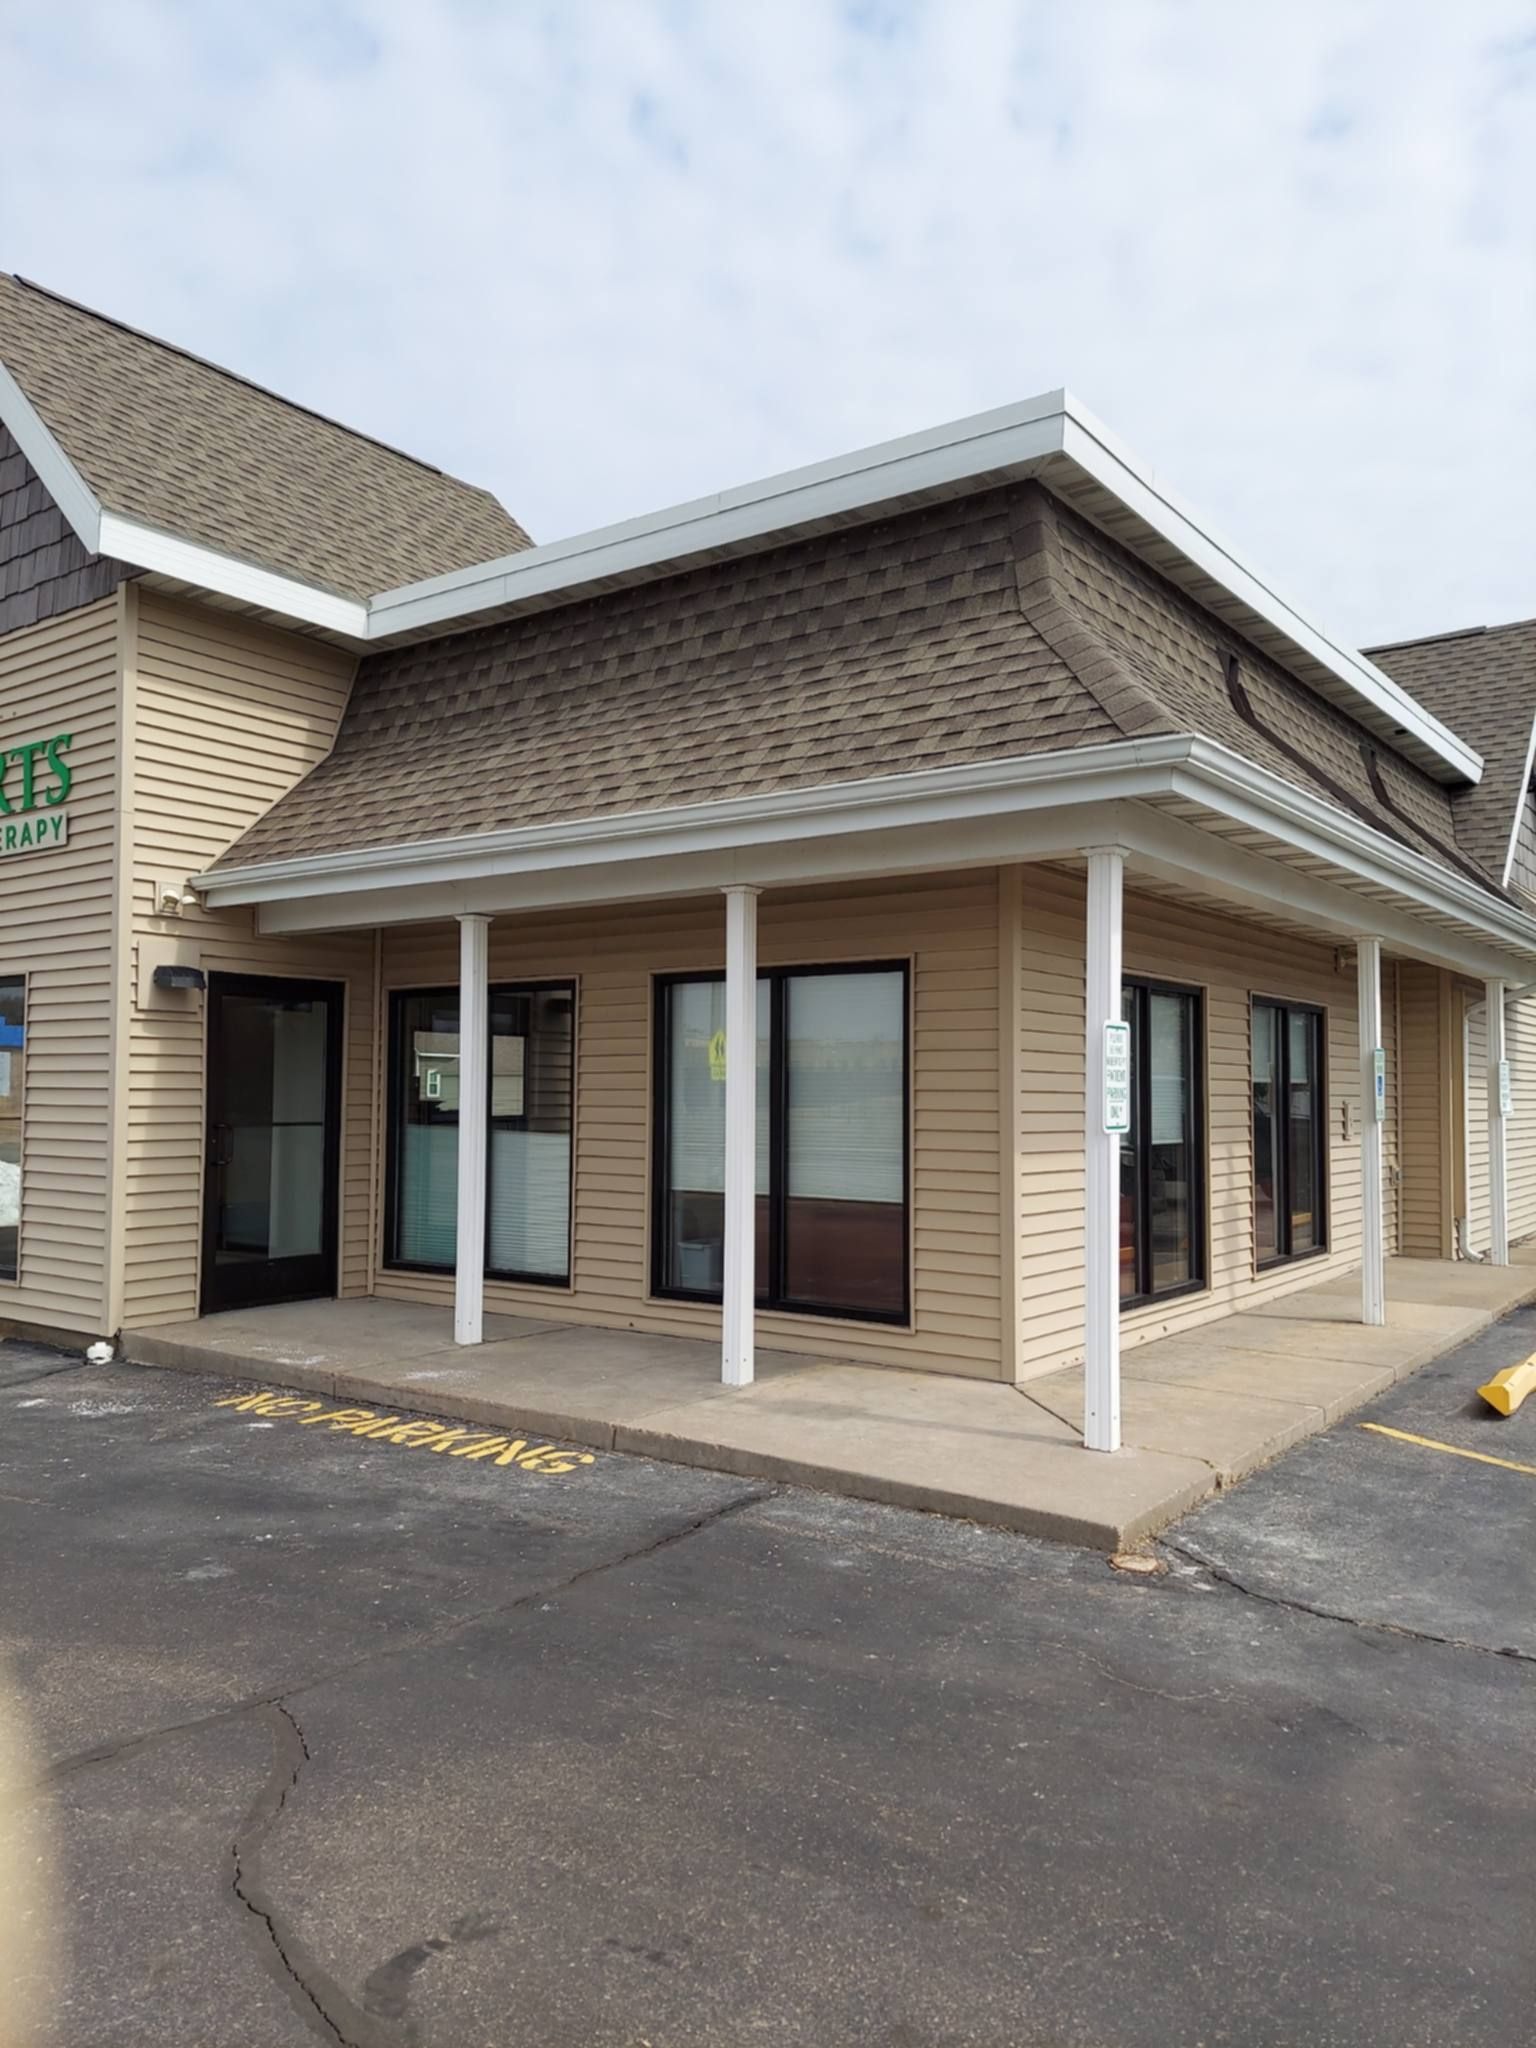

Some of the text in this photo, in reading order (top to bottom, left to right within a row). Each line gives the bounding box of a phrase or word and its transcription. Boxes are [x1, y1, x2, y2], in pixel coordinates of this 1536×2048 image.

[0, 815, 63, 852] RAPY
[213, 1391, 596, 1475] NO PARKING
